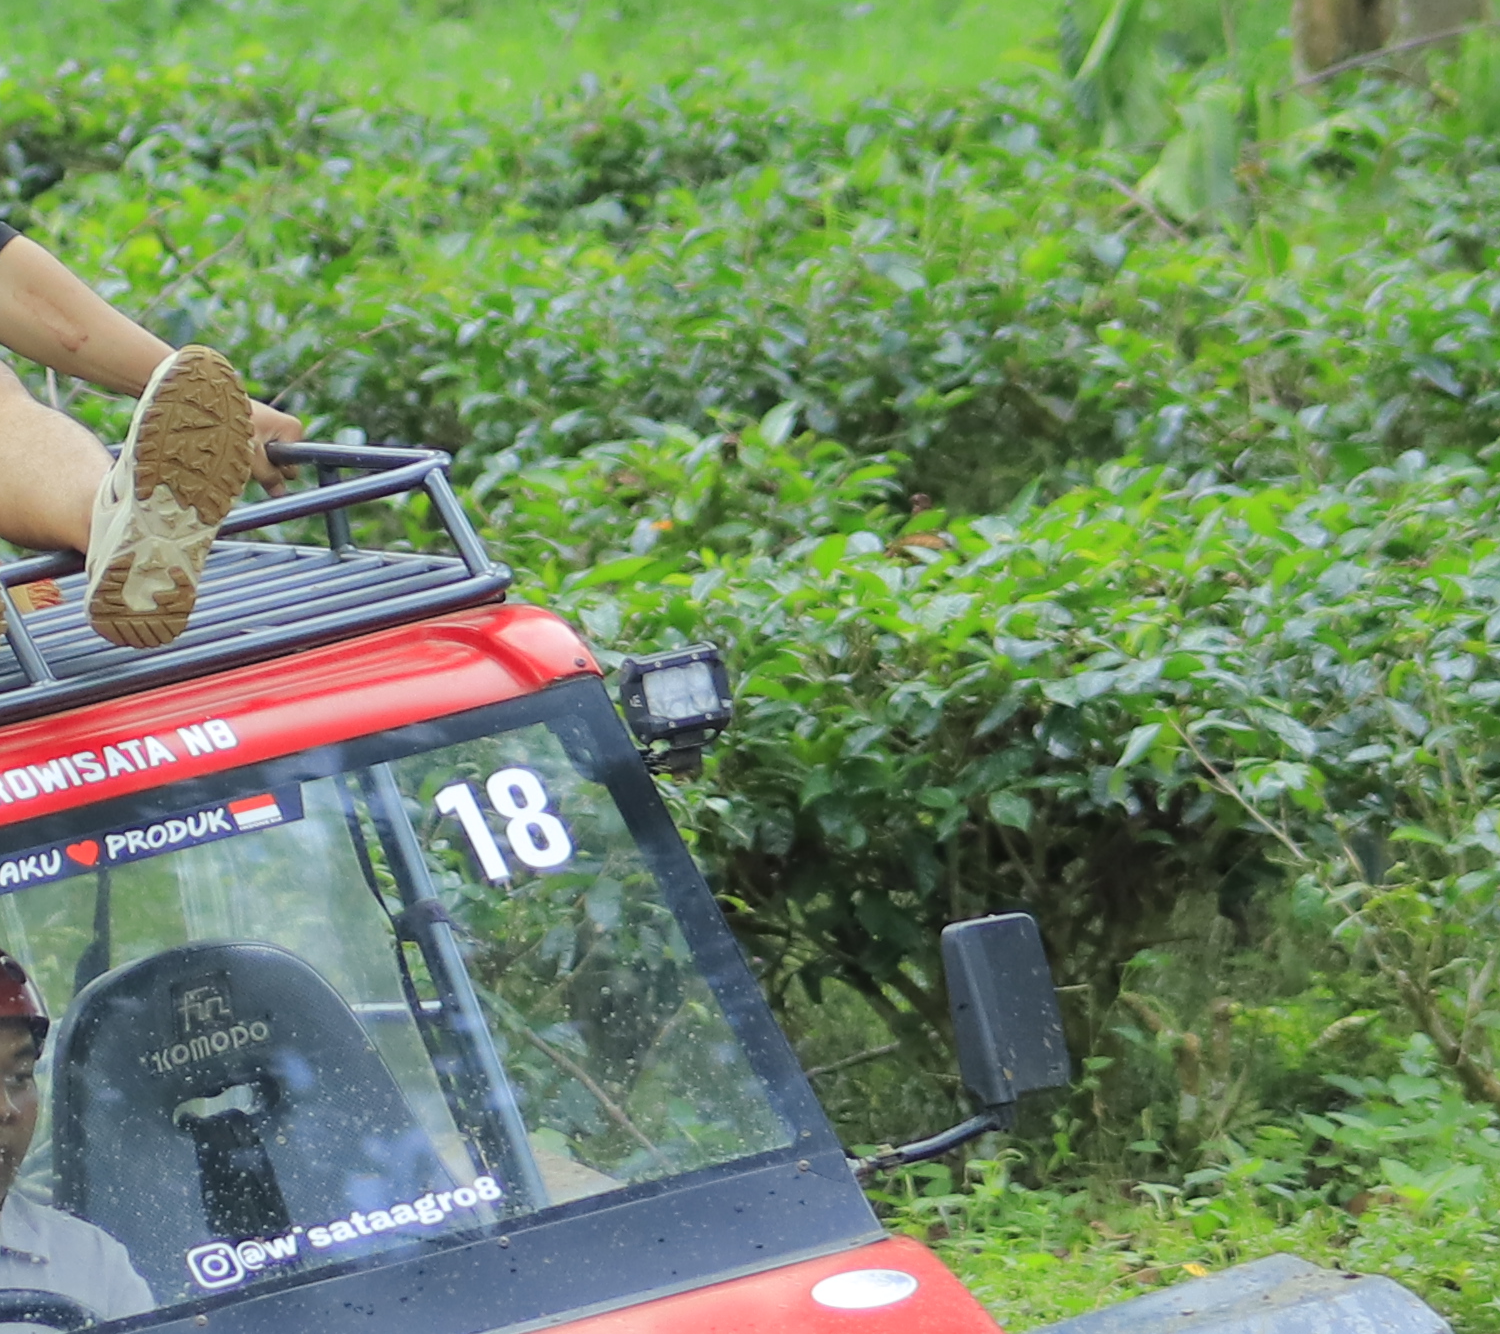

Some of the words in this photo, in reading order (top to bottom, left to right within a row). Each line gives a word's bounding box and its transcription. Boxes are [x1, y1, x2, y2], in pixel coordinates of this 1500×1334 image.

[104, 806, 232, 859] PRODUK
[434, 768, 573, 882] 18
[152, 1020, 270, 1073] KOMODO
